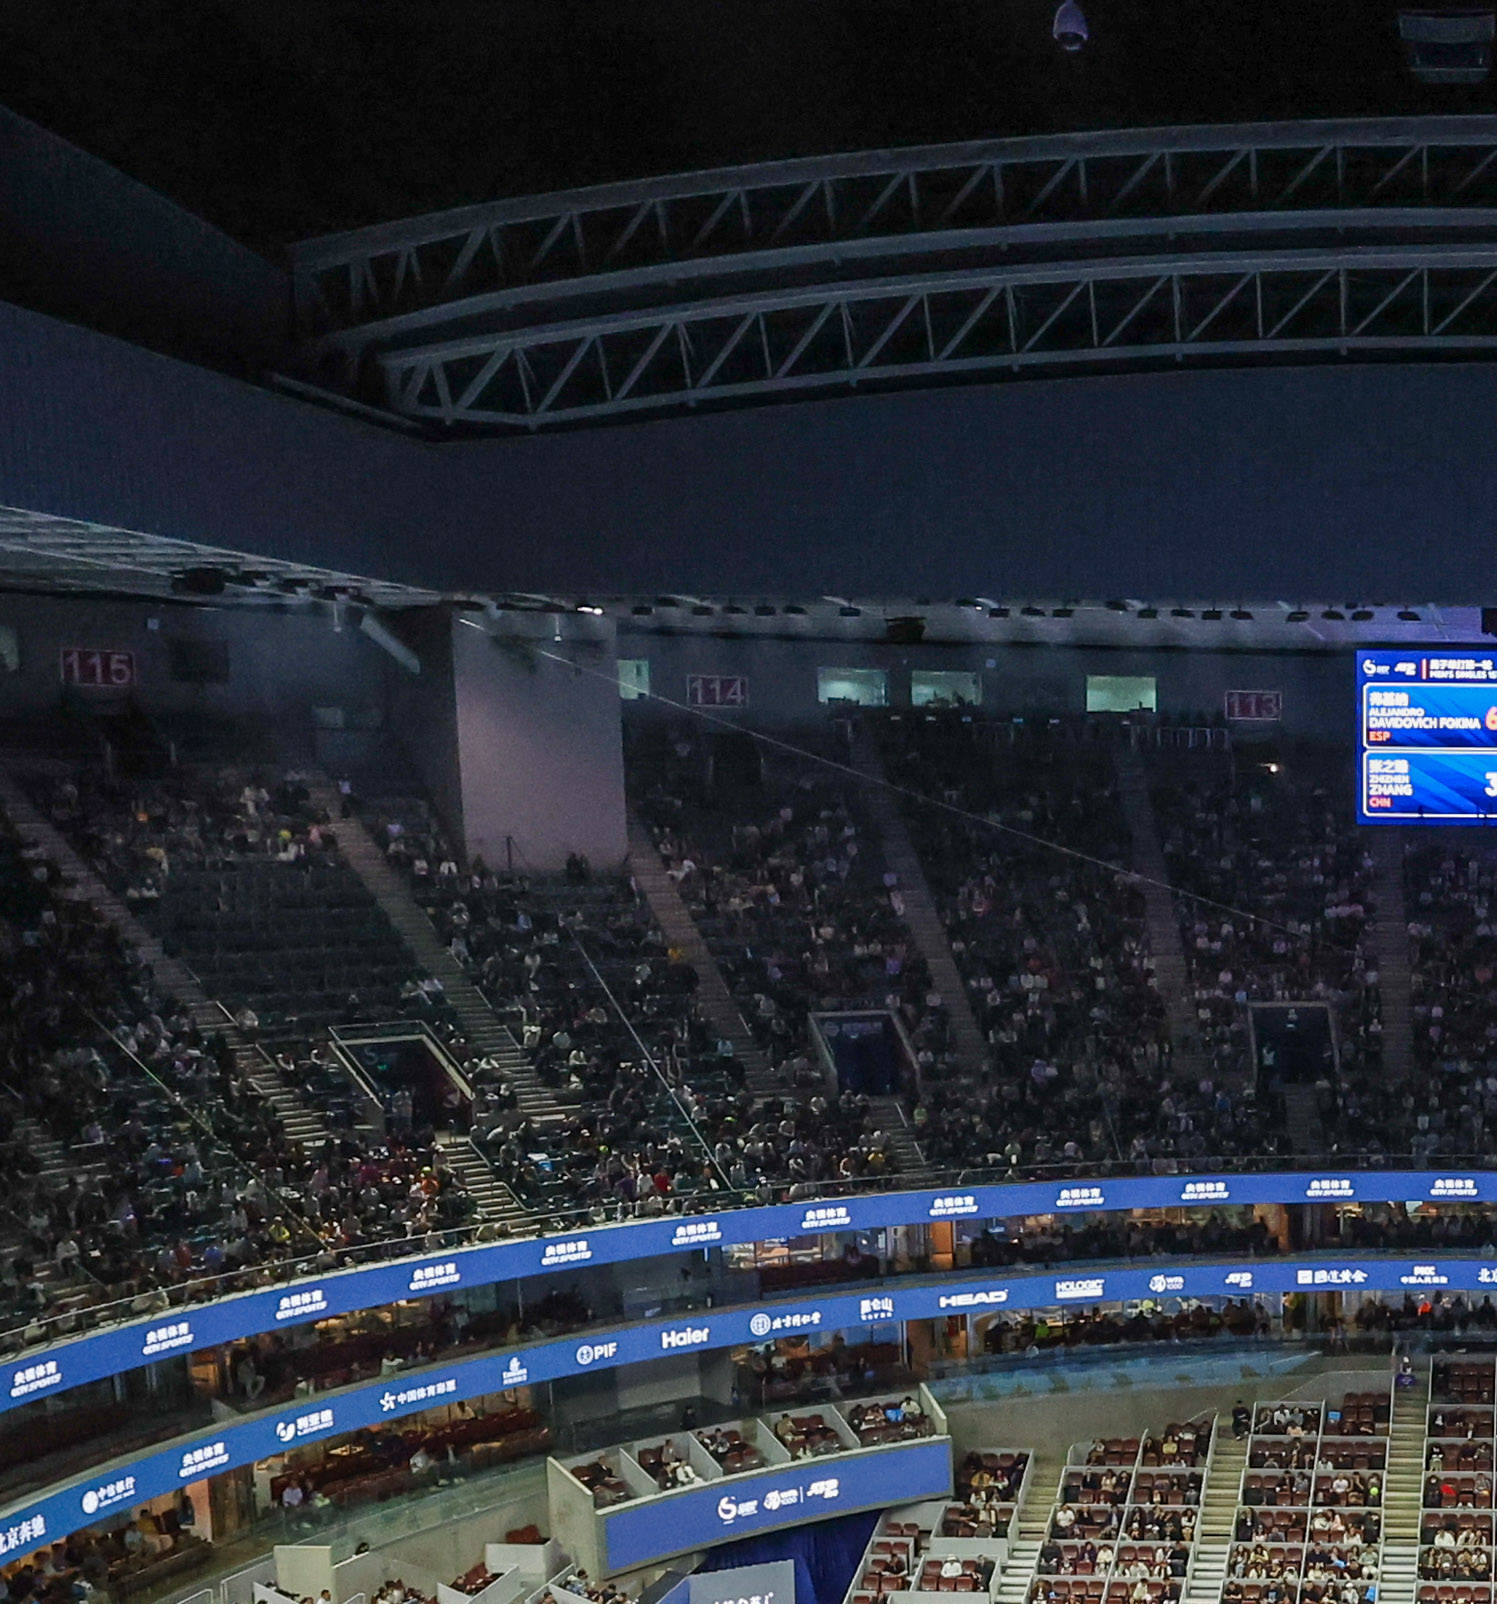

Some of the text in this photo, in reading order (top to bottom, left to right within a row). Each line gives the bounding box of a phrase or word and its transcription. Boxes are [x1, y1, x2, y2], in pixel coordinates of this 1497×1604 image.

[64, 653, 133, 684] 115
[691, 679, 746, 706] 114
[1229, 693, 1280, 718] 113
[1369, 708, 1424, 717] ALEJANDRO
[1369, 717, 1482, 729] DAVIDOVICH FOKINA
[1369, 732, 1391, 741] ESP
[1369, 775, 1410, 785] ZHIZHEN
[1369, 785, 1413, 796] ZHANG
[1369, 798, 1391, 808] CHN
[1056, 1280, 1104, 1294] HOLOGIC
[940, 1290, 1007, 1307] HEAD
[662, 1328, 709, 1348] Haier
[594, 1343, 616, 1359] PIF
